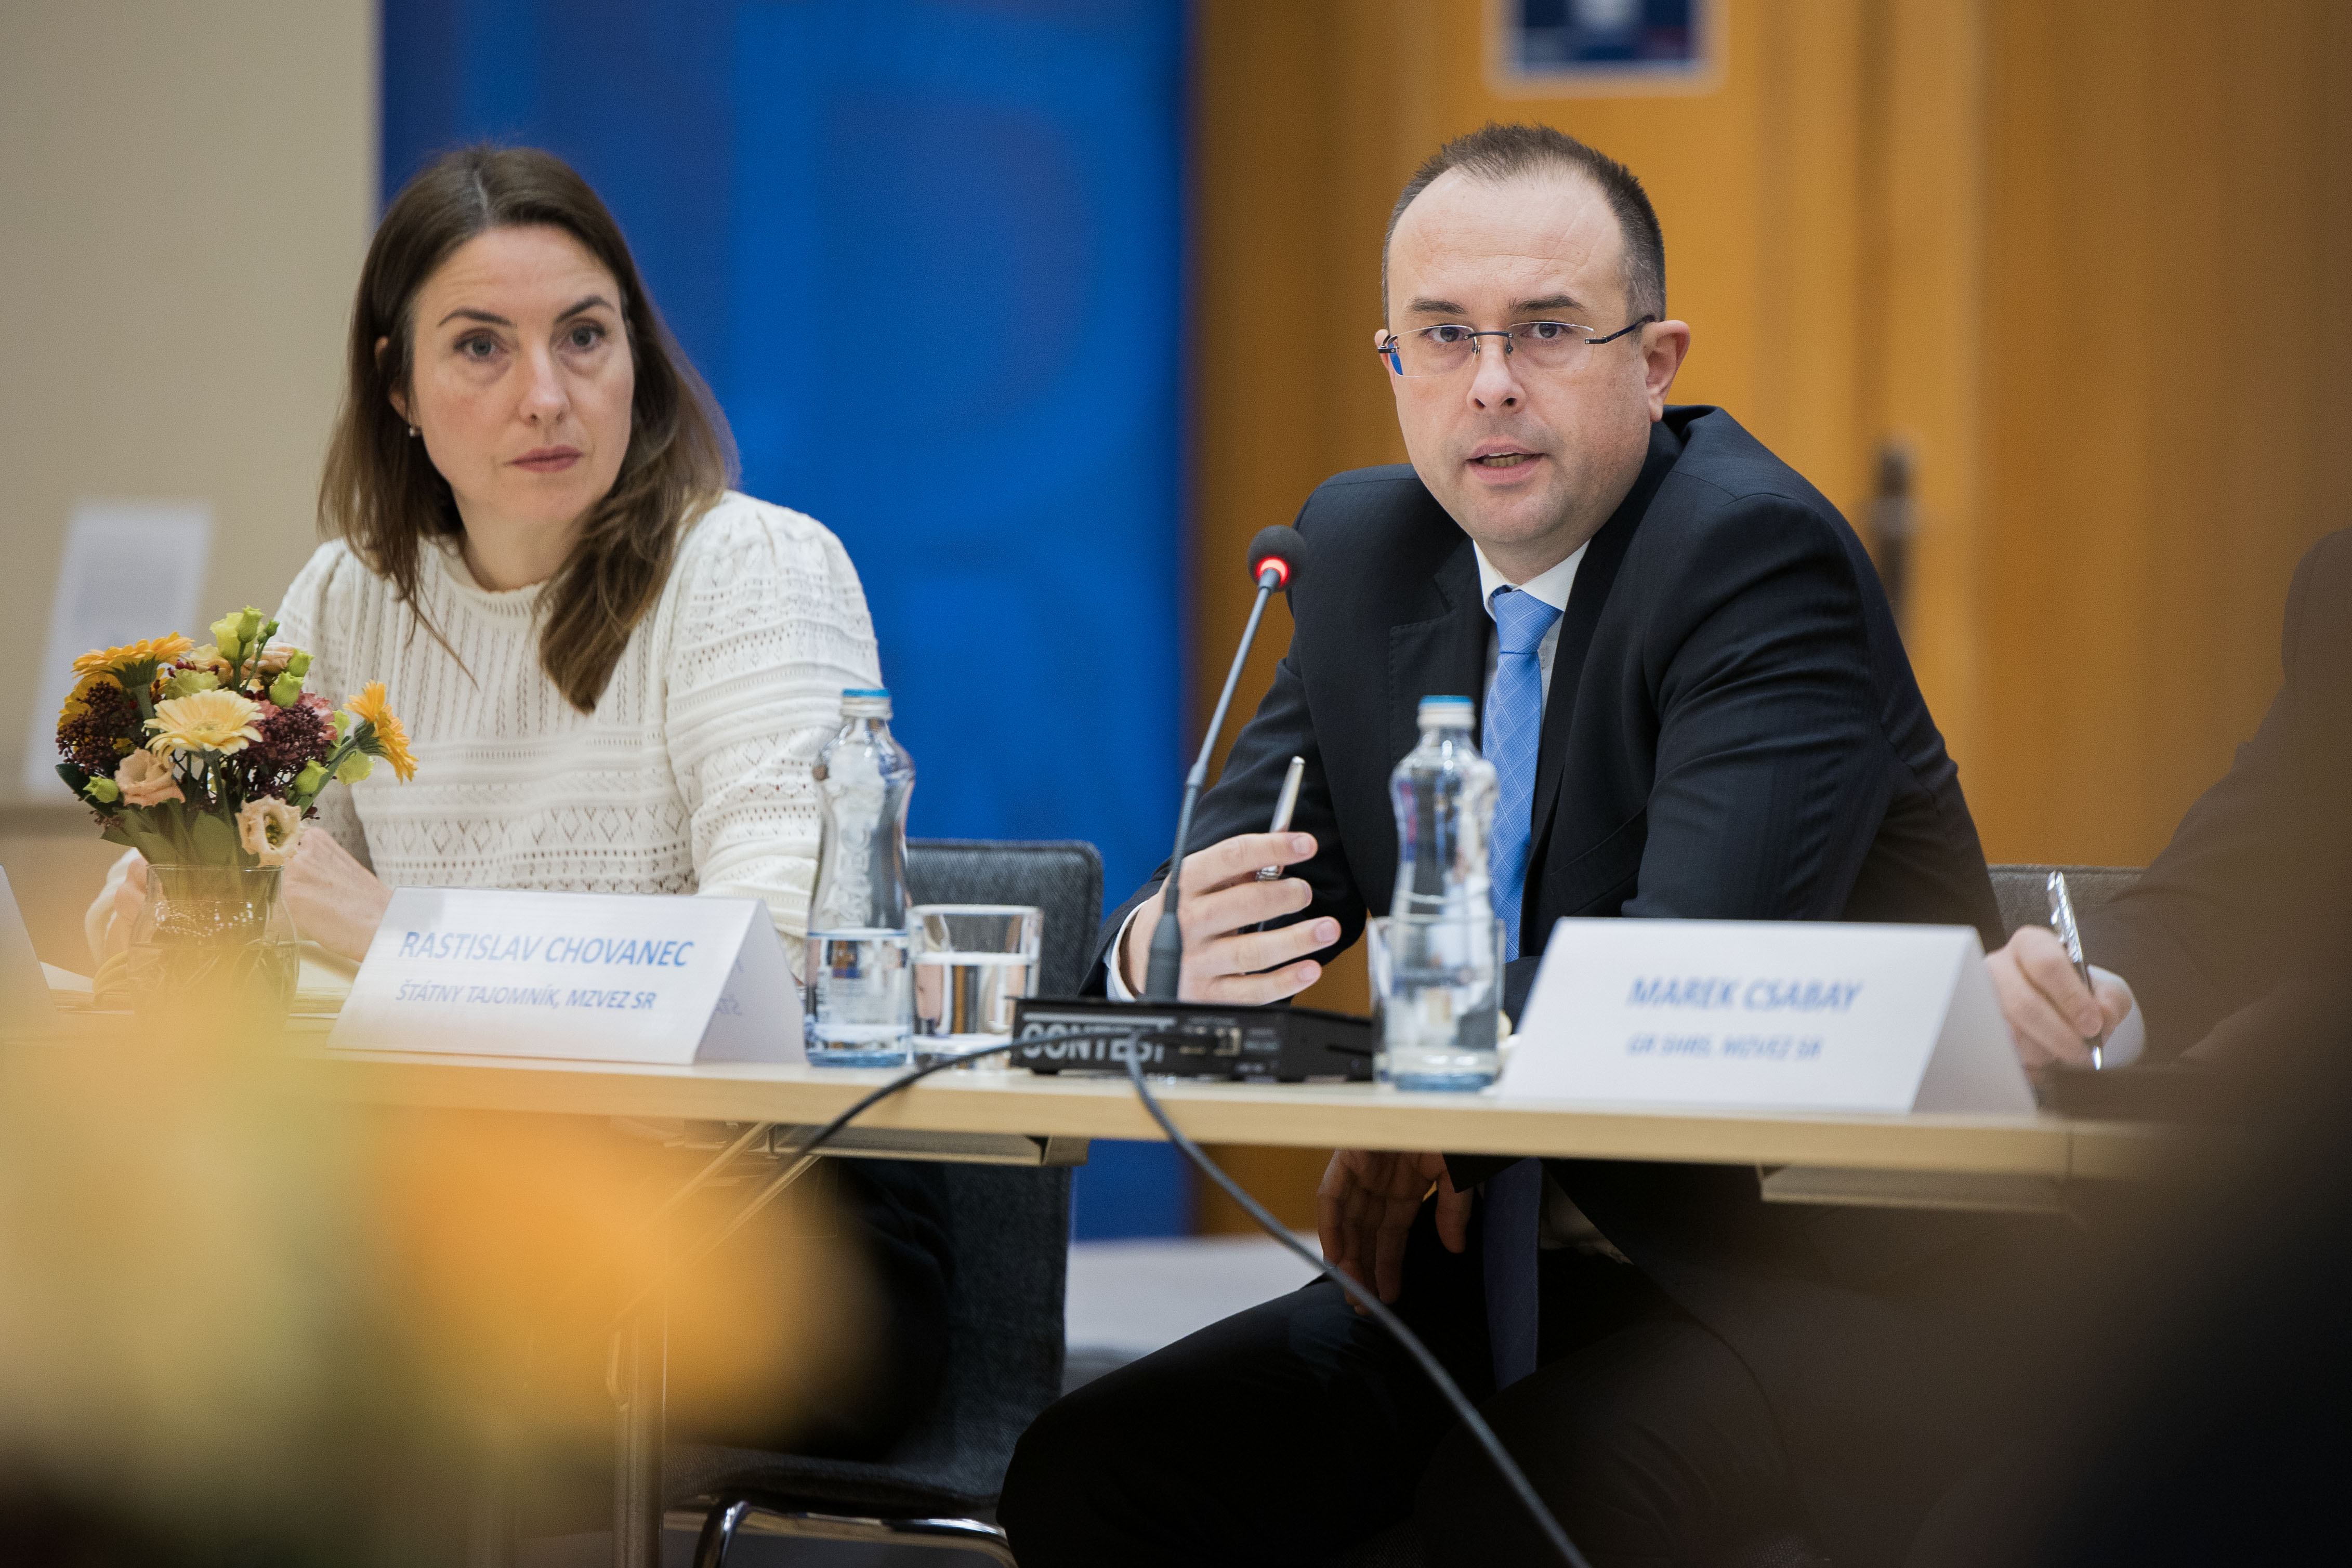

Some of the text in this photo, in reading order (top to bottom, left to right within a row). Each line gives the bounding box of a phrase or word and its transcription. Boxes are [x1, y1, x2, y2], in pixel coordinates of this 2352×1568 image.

[398, 930, 695, 968] RASTISLAV CHOVANEC
[396, 979, 657, 1010] ŠTÁTNY TAJOMNÍK, MZVEZ SR
[1626, 976, 1864, 1013] MAREK CSABAY
